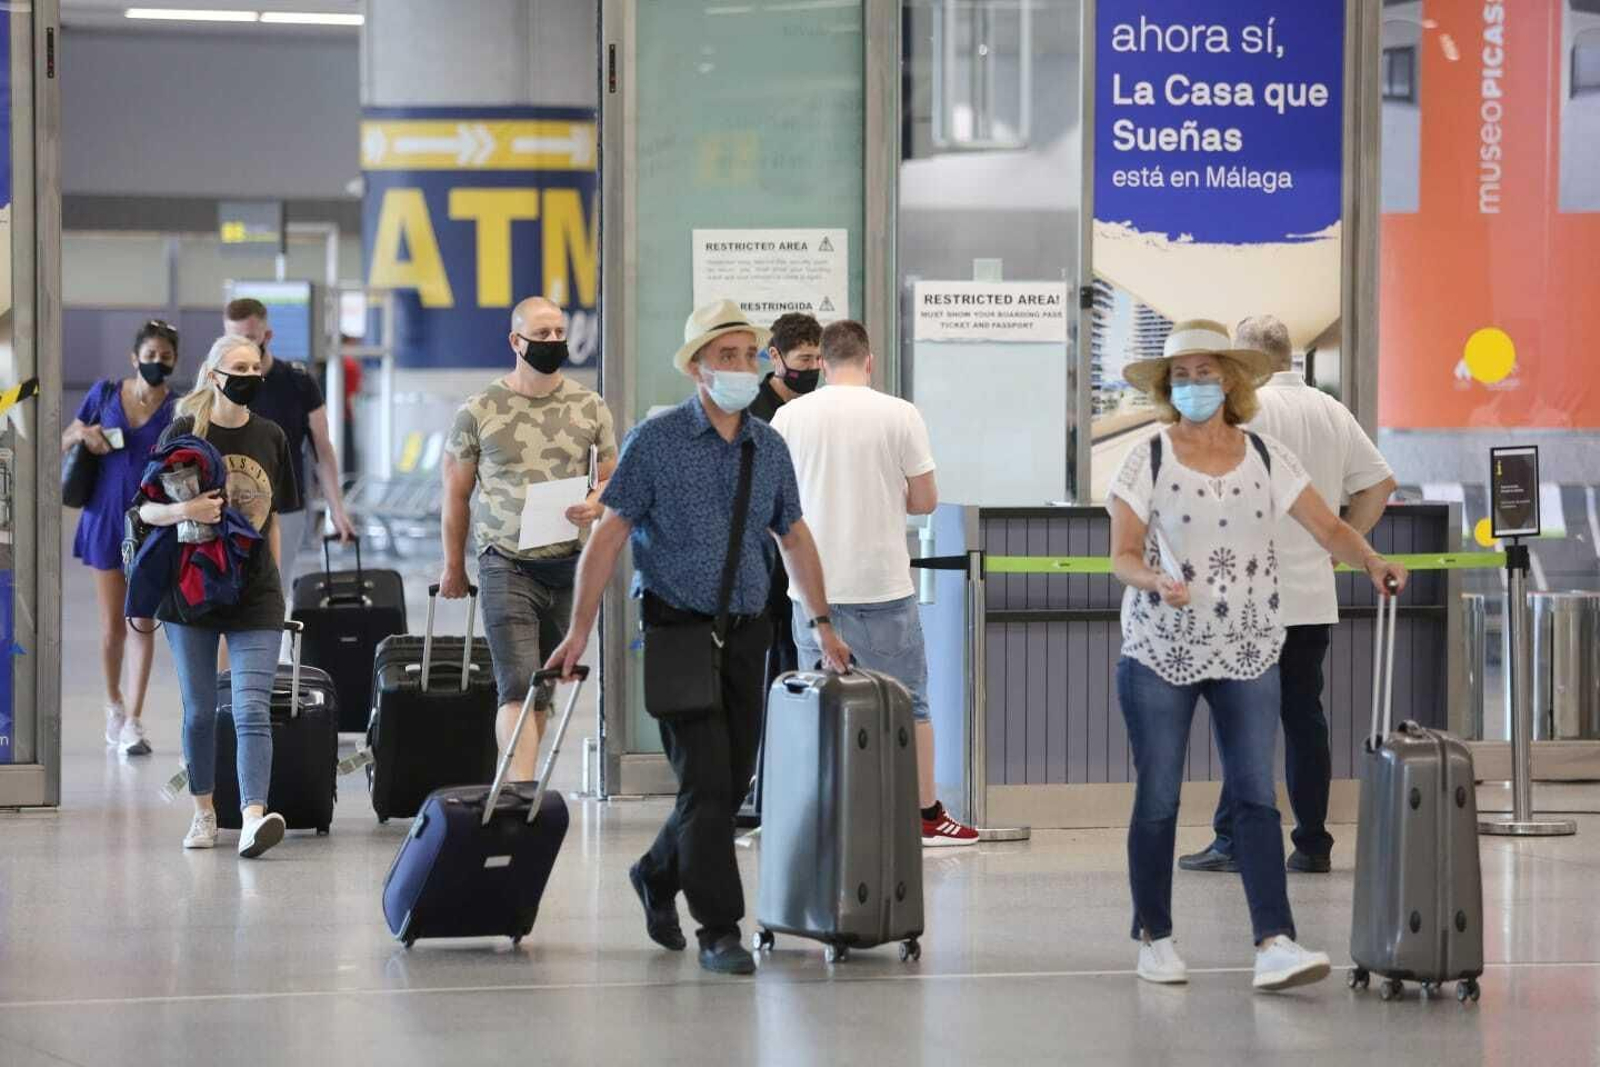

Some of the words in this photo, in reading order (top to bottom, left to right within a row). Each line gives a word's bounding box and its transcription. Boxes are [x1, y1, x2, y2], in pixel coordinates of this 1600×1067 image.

[1112, 15, 1231, 52] ahora
[1241, 17, 1284, 58] sí,
[1112, 73, 1155, 106] La
[1164, 73, 1255, 107] Casa
[1264, 82, 1329, 115] que
[1479, 0, 1505, 214] museoPICAS
[1112, 118, 1243, 152] Sueñas
[1112, 165, 1165, 188] está
[1170, 170, 1200, 188] en
[1206, 165, 1293, 194] Málaga
[705, 241, 776, 251] RESTRICTED
[778, 241, 808, 251] AREA
[740, 301, 814, 311] RESTRINGIDA
[923, 293, 1013, 305] RESTRICTED
[1017, 294, 1061, 306] AREA!
